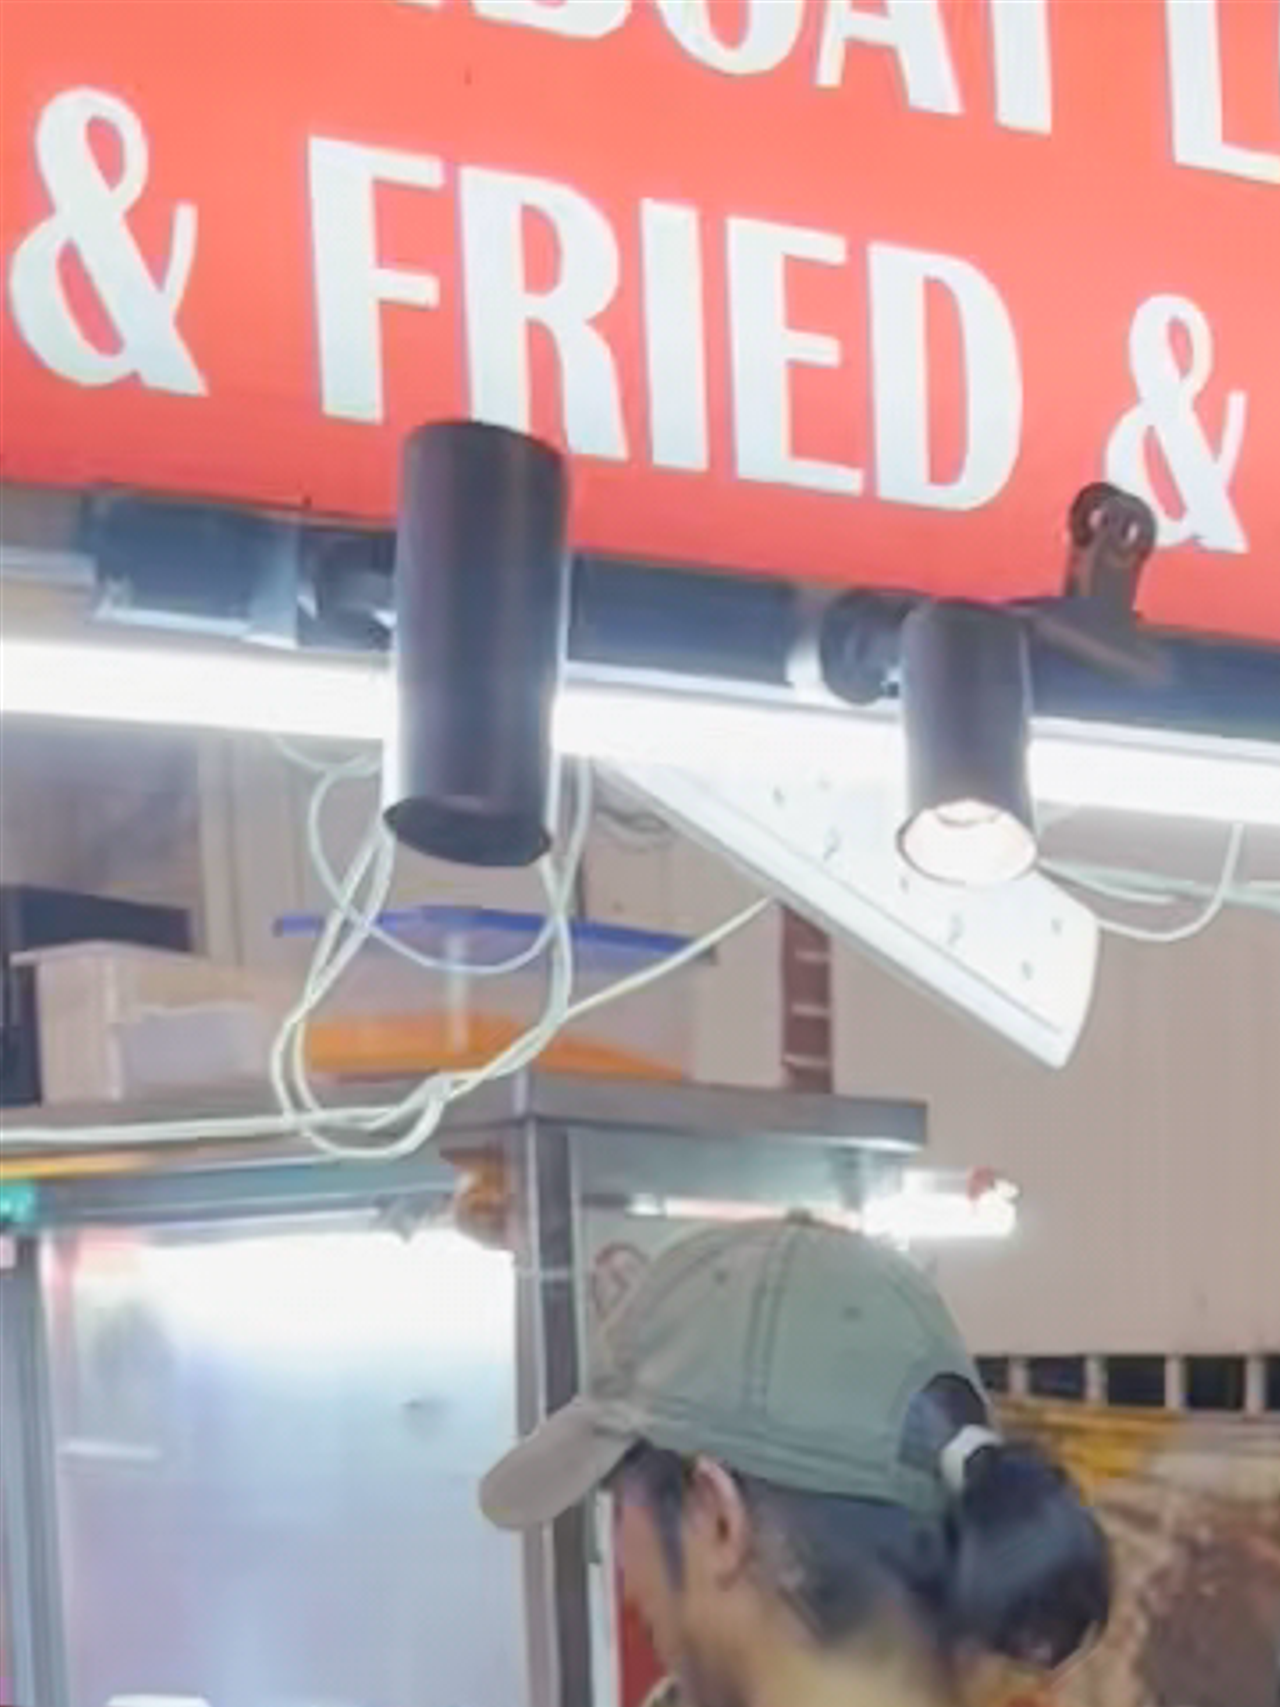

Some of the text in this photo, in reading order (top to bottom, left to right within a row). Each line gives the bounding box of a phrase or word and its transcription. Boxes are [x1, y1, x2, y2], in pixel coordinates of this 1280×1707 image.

[9, 87, 208, 396] &
[307, 136, 1023, 511] FRIED
[1104, 294, 1248, 554] &
